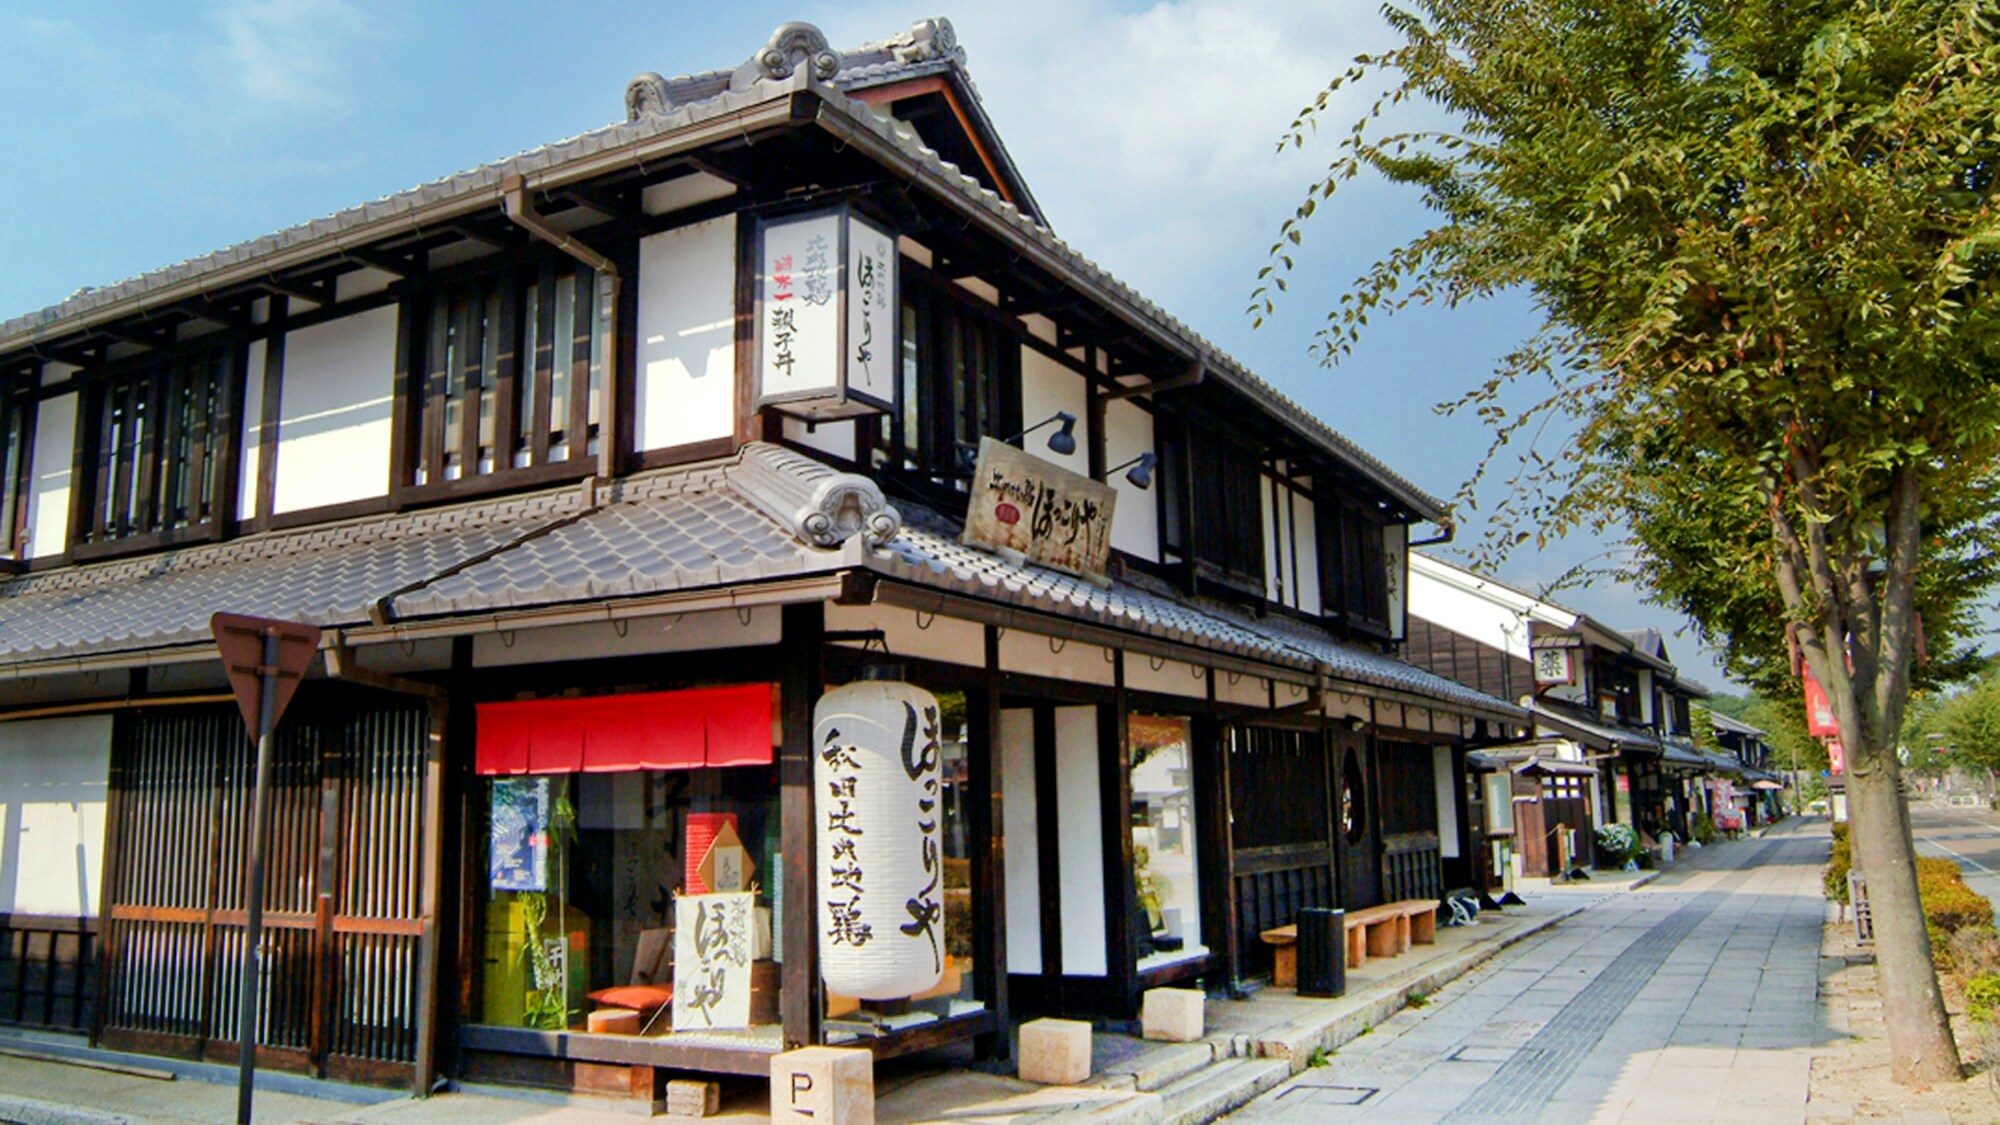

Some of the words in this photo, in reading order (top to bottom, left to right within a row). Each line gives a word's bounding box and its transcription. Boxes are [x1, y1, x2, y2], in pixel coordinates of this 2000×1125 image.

[857, 250, 874, 386] ほっこりや
[1031, 480, 1097, 557] ほっこりや
[822, 728, 873, 947] 秋田比内地鶏
[900, 700, 940, 974] ほっこりや
[687, 900, 733, 1026] ほっこりや
[791, 1072, 813, 1104] P
